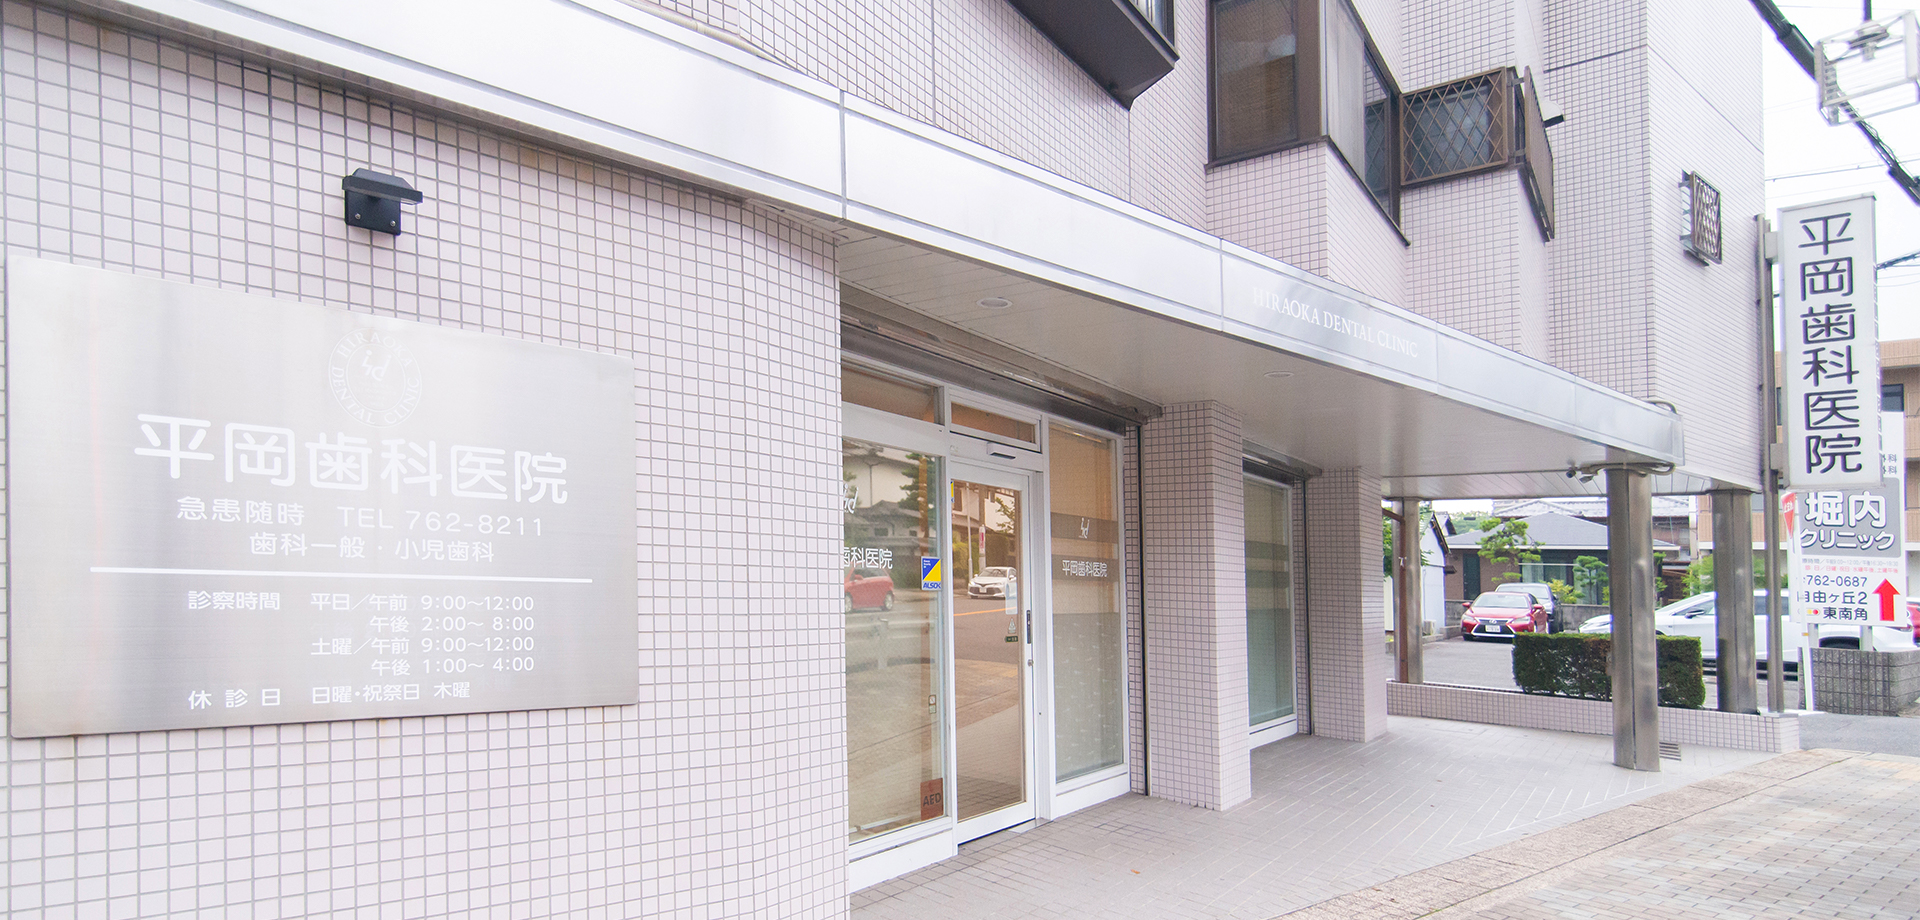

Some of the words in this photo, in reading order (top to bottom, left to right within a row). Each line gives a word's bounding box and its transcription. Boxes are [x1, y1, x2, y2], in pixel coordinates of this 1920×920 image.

[1253, 287, 1321, 326] HIRAOKA
[1323, 310, 1375, 344] DENTAL
[1377, 330, 1418, 358] CLINIC
[337, 332, 413, 367] HIRAOKA
[1798, 212, 1862, 474] 平岡歯科医院
[134, 413, 569, 504] 平岡歯科医院
[177, 495, 305, 526] 急患随時
[337, 506, 394, 529] TEL
[406, 510, 543, 537] 762-8211
[1805, 491, 1887, 528] 堀内
[1800, 528, 1895, 550] クリニック
[1062, 559, 1107, 578] 平岡歯科医院
[188, 590, 280, 611] 診察時間
[369, 615, 410, 633] 午後
[1823, 606, 1868, 621] 東南角
[371, 658, 411, 676] 午後
[312, 683, 420, 704] 日曜・祝祭日
[434, 681, 470, 699] 木曜
[922, 792, 942, 807] AED
